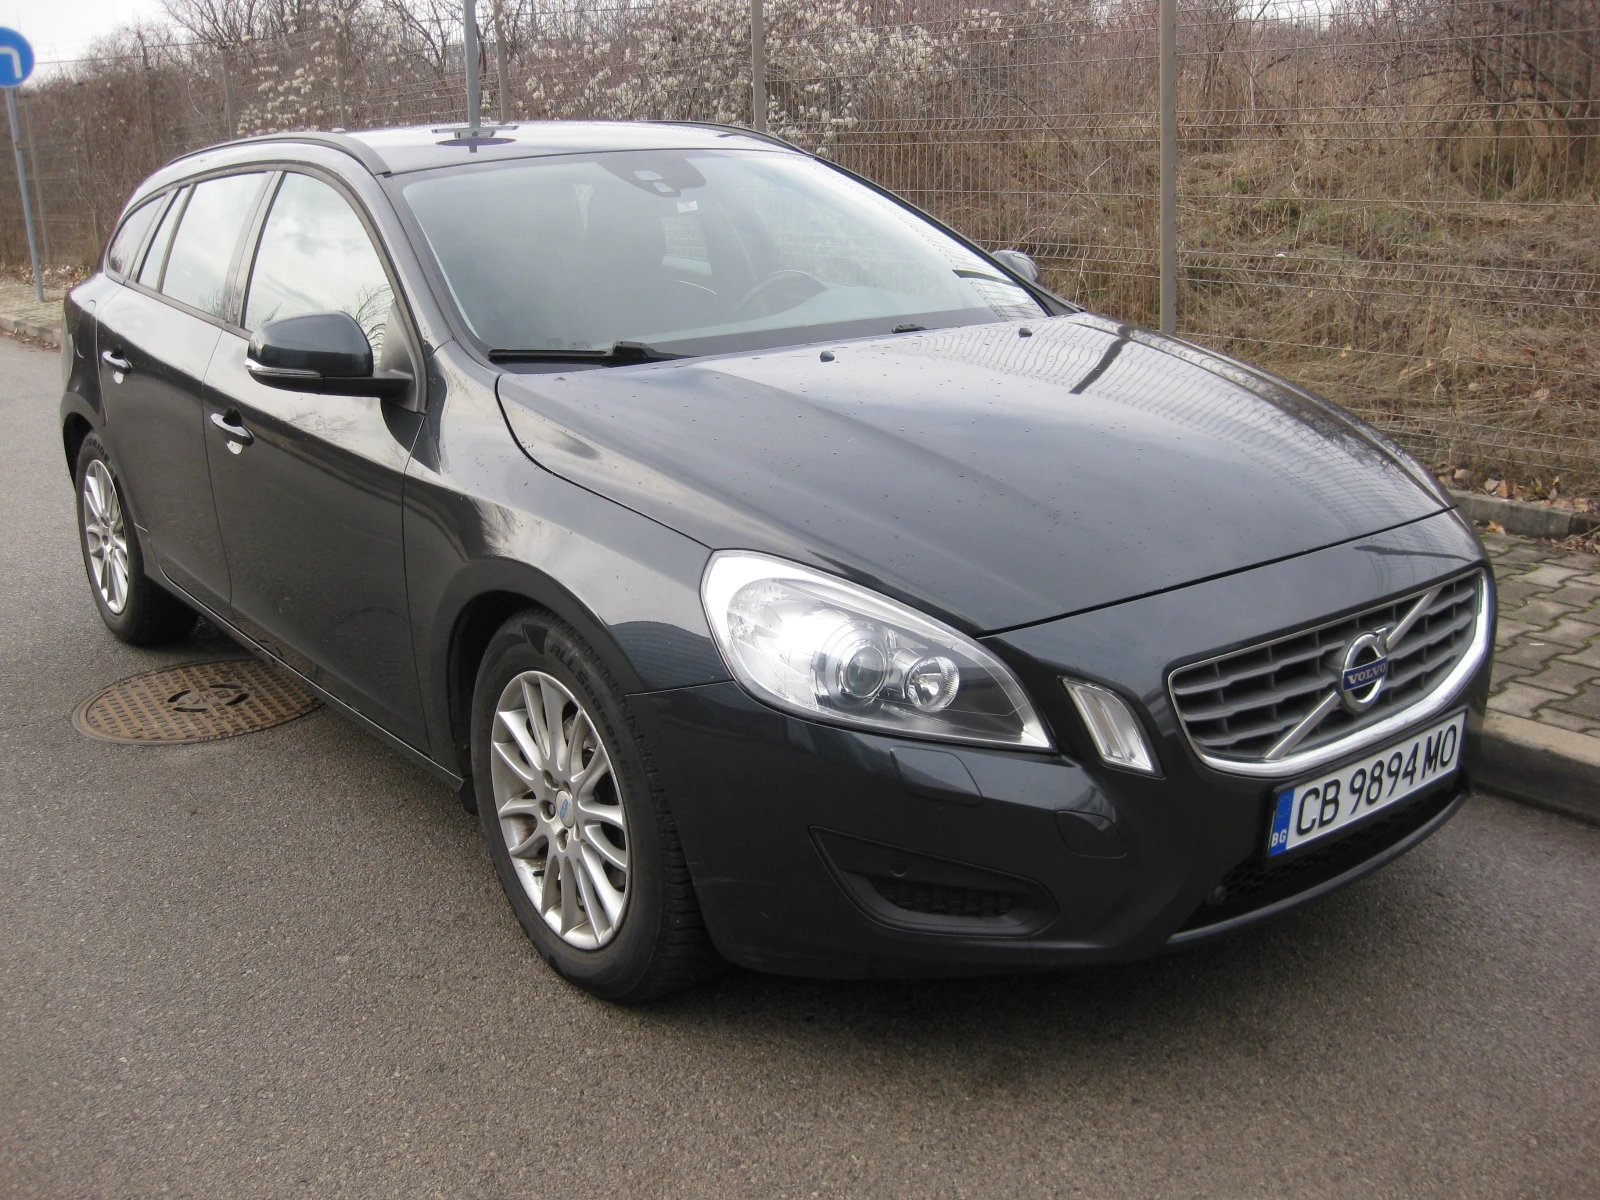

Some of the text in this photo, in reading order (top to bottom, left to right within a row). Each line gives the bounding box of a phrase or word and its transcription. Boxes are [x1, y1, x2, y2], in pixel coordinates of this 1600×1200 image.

[1347, 663, 1386, 685] VOLVO
[1296, 724, 1457, 837] CB 9894 MO
[1271, 829, 1287, 848] BG
